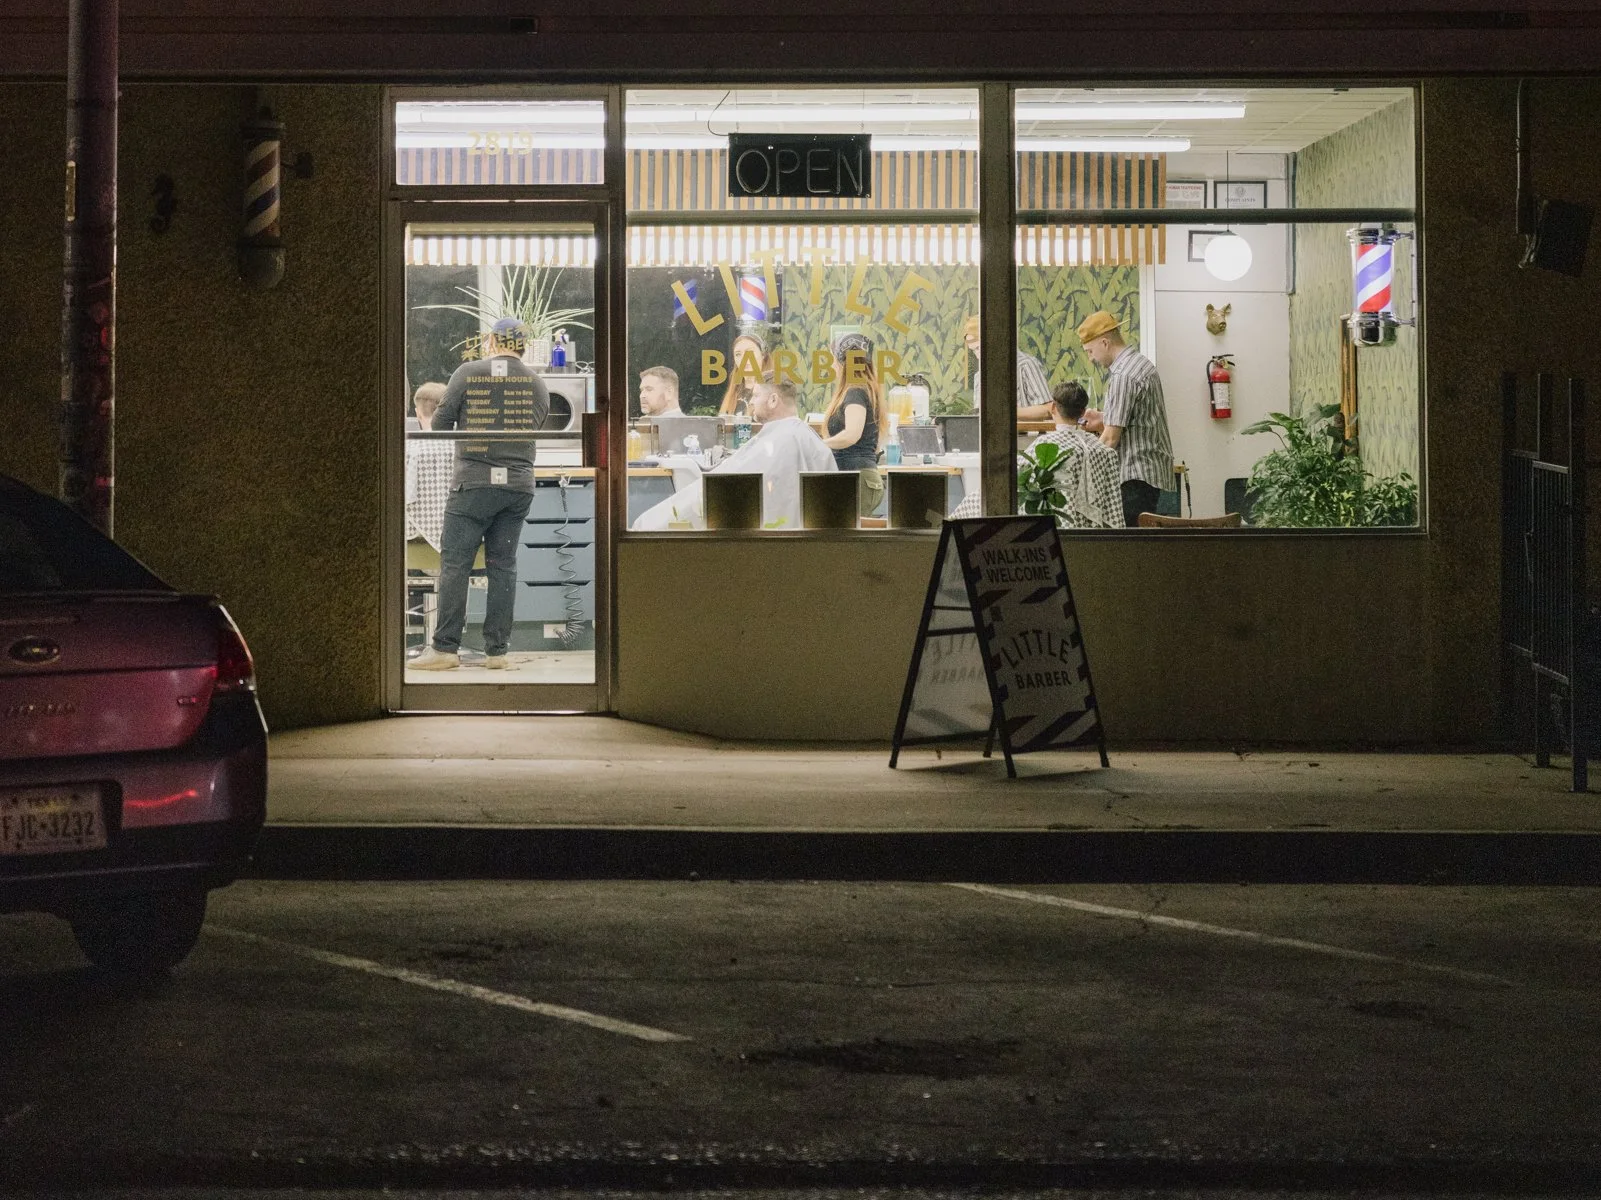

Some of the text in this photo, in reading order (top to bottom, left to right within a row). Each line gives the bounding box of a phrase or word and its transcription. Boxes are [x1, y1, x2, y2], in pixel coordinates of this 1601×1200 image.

[467, 130, 534, 155] 2819
[736, 149, 863, 195] OPEN
[671, 247, 935, 335] LITTLE
[701, 349, 909, 386] BARBER
[983, 549, 1047, 565] WALK-INS
[986, 566, 1051, 583] WELCOME
[1001, 629, 1069, 668] LITTLE
[1015, 671, 1072, 689] BARBER
